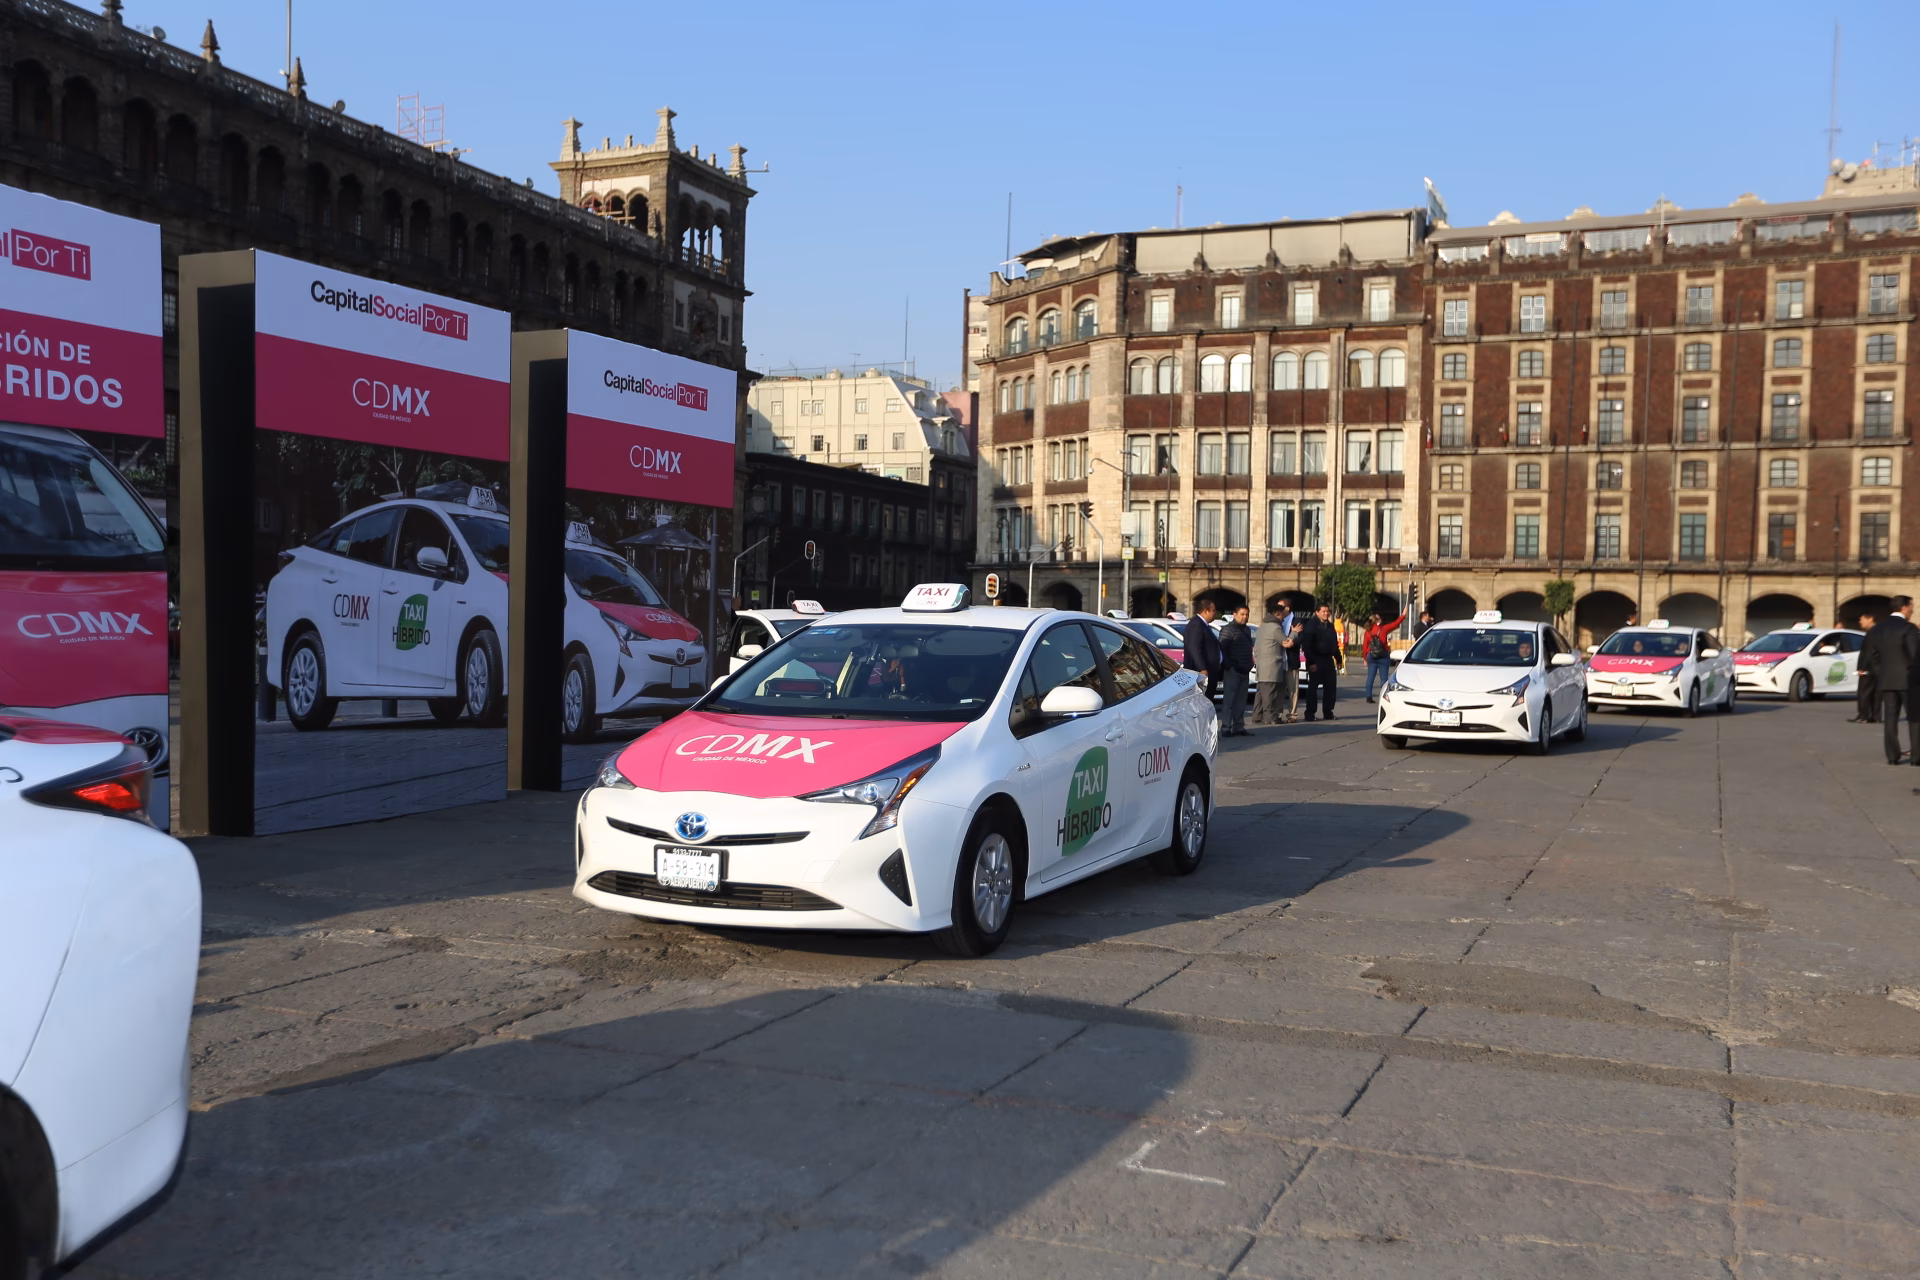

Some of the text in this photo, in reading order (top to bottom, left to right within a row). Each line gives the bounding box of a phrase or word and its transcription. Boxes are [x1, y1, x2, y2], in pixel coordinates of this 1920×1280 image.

[15, 234, 59, 268] Por
[64, 245, 86, 274] Ti
[424, 307, 450, 332] Por
[453, 314, 466, 336] Ti
[0, 329, 91, 365] IÓN DE
[0, 363, 123, 409] RIDOS
[352, 377, 430, 417] CDMX
[678, 386, 695, 405] Por
[697, 390, 706, 408] Ti
[630, 444, 682, 474] CDMX
[475, 487, 493, 499] TAXI
[573, 522, 588, 534] TAXI
[917, 587, 950, 597] TAXI
[333, 593, 370, 621] CDMX
[403, 603, 425, 622] TAXI
[645, 613, 676, 624] CDMX
[17, 611, 153, 639] CDMX
[392, 623, 431, 646] HÍBRIDO
[1607, 658, 1655, 667] CDMX
[675, 733, 835, 764] CDMX
[1138, 745, 1171, 779] CDMX
[1074, 765, 1104, 799] TAXI
[1056, 801, 1112, 847] HÍBRIDO
[669, 876, 707, 890] AEROPUERTO
